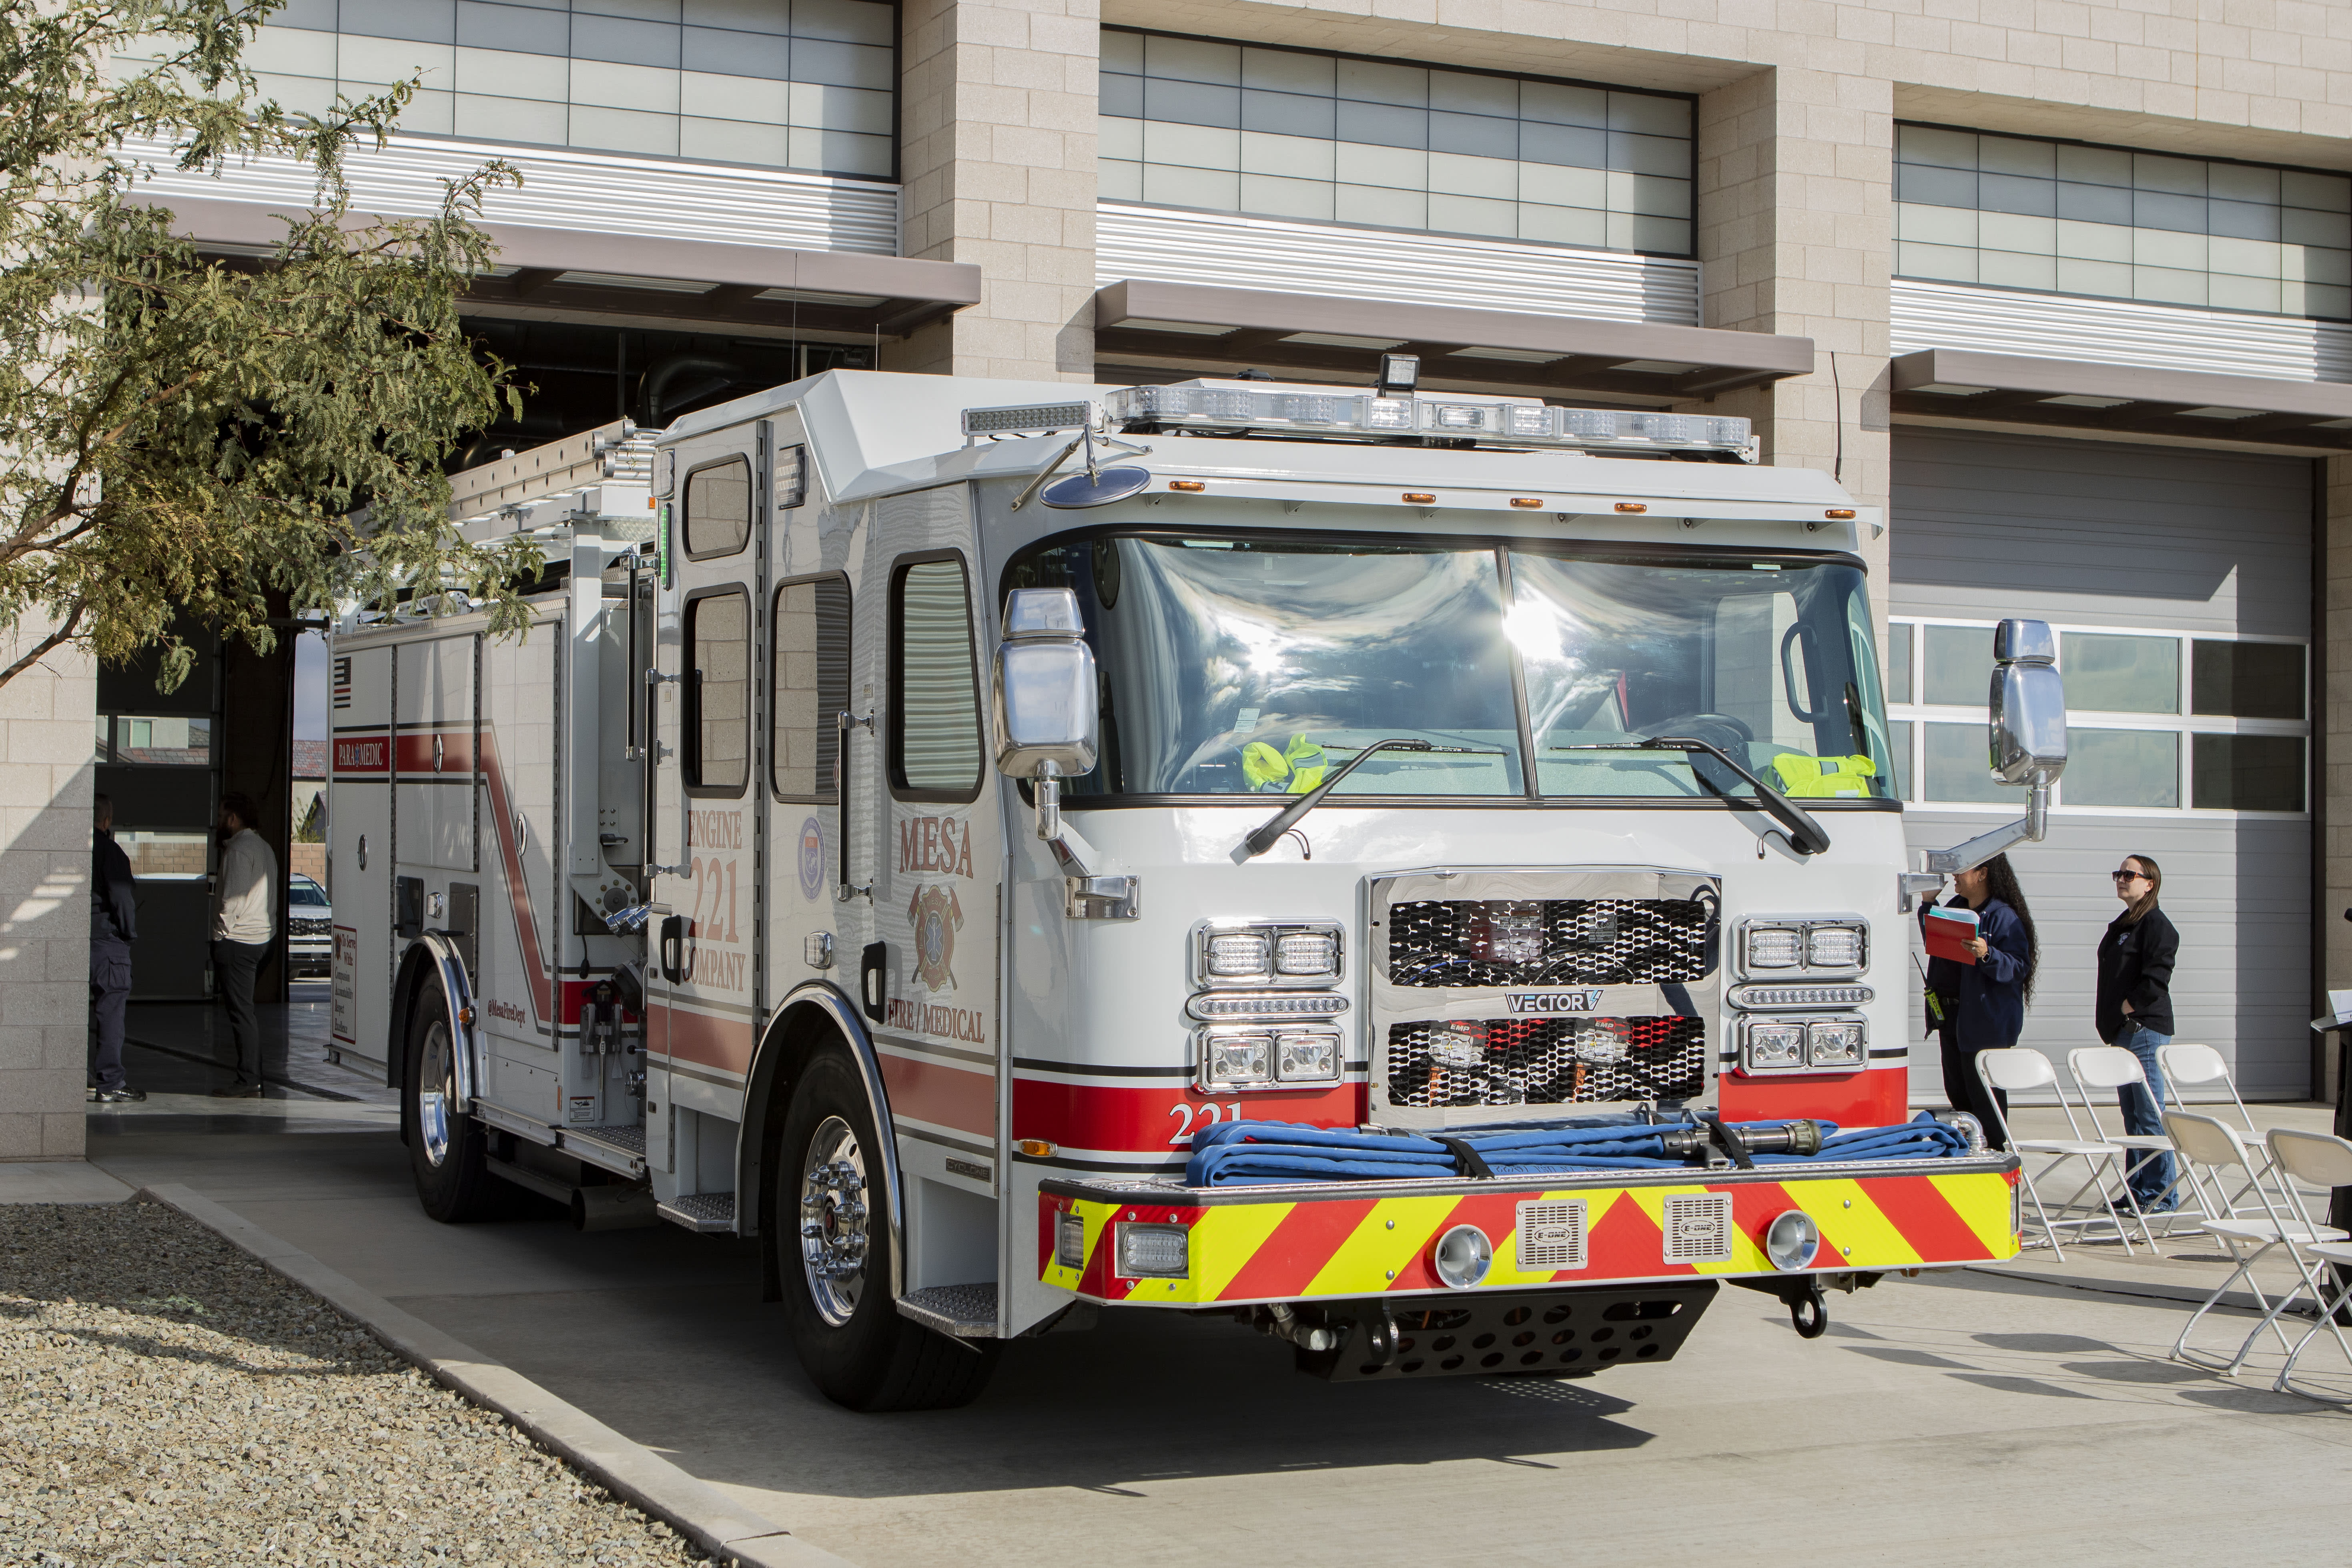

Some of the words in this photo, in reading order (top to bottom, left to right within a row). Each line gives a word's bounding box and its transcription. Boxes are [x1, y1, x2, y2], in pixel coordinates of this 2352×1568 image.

[687, 810, 742, 849] ENGINE
[899, 817, 974, 879] MESA
[688, 856, 739, 943] 221
[927, 897, 942, 910] MESA
[342, 934, 346, 946] To
[347, 935, 355, 949] Serve
[335, 966, 350, 983] Compassion
[682, 945, 746, 992] COMPANY
[335, 983, 353, 1003] Accountability
[335, 999, 345, 1017] Respect
[1509, 994, 1583, 1012] VECTOR
[487, 999, 525, 1029] @MesaFireDept
[887, 997, 914, 1031] FIRE
[922, 1003, 985, 1044] MEDICAL
[335, 1018, 348, 1034] Excellence
[1450, 1024, 1470, 1032] EMP
[947, 1160, 989, 1179] CYCLONE
[1537, 1231, 1567, 1240] E-ONE
[1683, 1224, 1712, 1233] E-ONE
